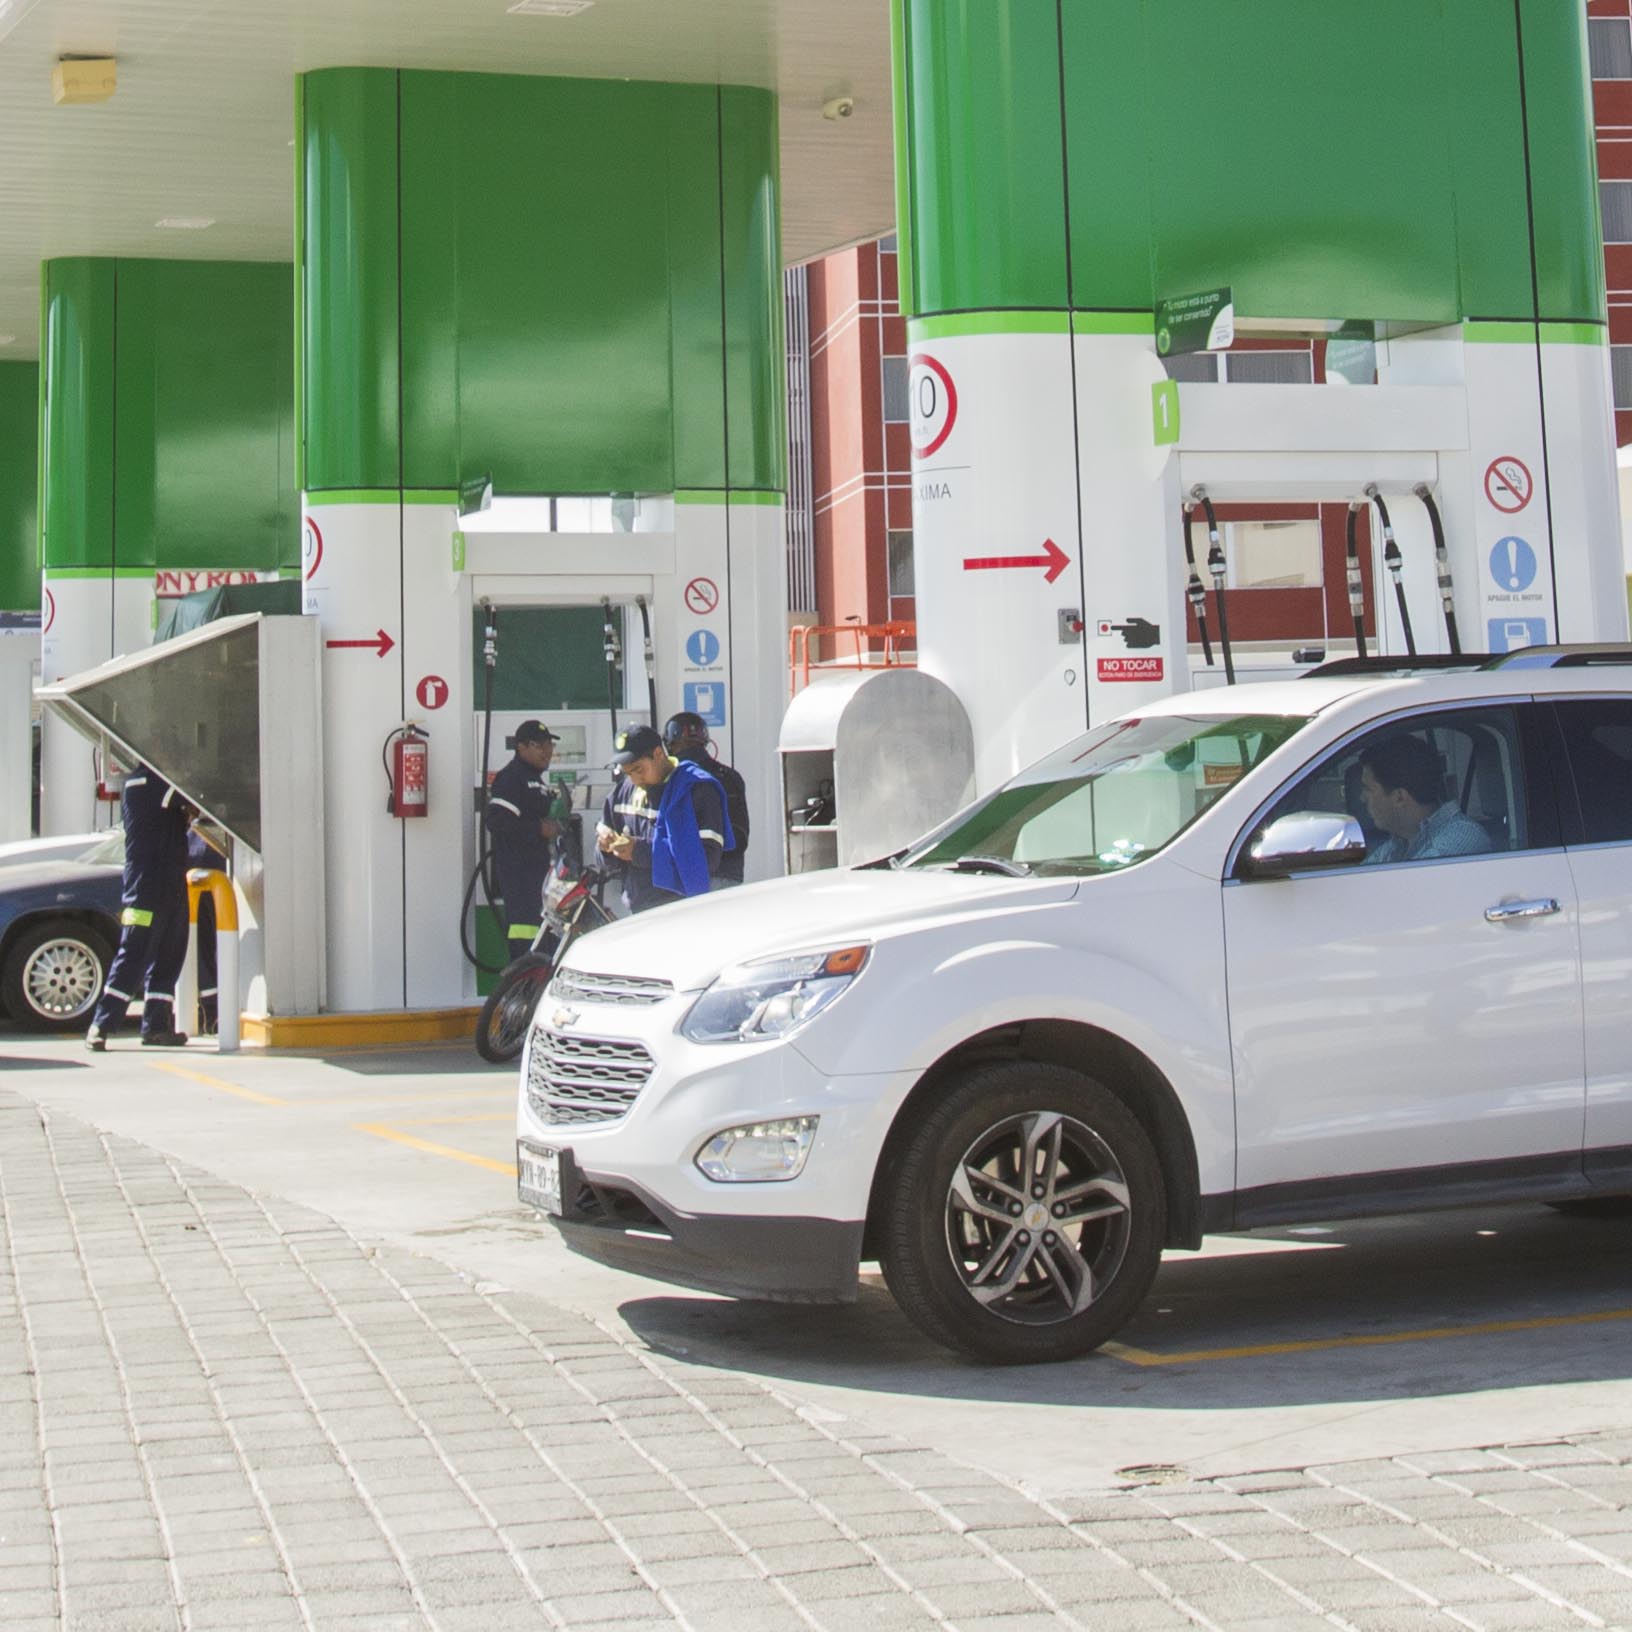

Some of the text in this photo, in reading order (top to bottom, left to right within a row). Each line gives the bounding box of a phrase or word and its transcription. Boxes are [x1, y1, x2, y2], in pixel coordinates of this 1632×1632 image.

[1160, 393, 1168, 428] 1
[919, 482, 952, 501] XIMA
[454, 540, 461, 561] 3
[157, 571, 200, 592] NY
[1104, 659, 1157, 671] NO TOCAR
